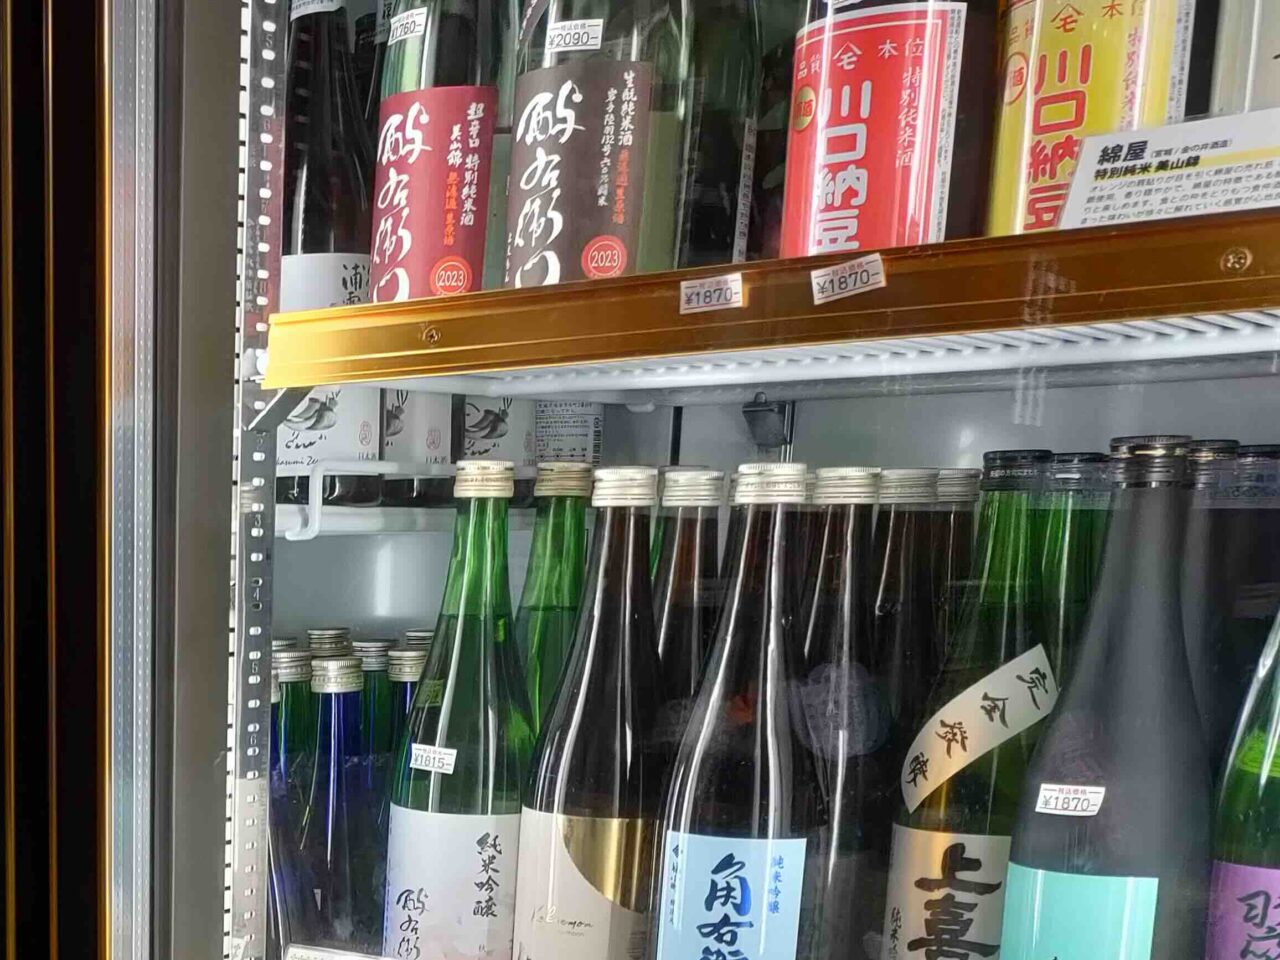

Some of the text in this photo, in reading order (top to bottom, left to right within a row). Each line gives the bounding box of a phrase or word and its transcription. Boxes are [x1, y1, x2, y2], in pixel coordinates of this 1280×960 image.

[1096, 139, 1149, 166] 綿屋
[590, 250, 619, 268] 2023
[438, 270, 465, 288] 2023
[472, 831, 504, 919] 純米吟醸
